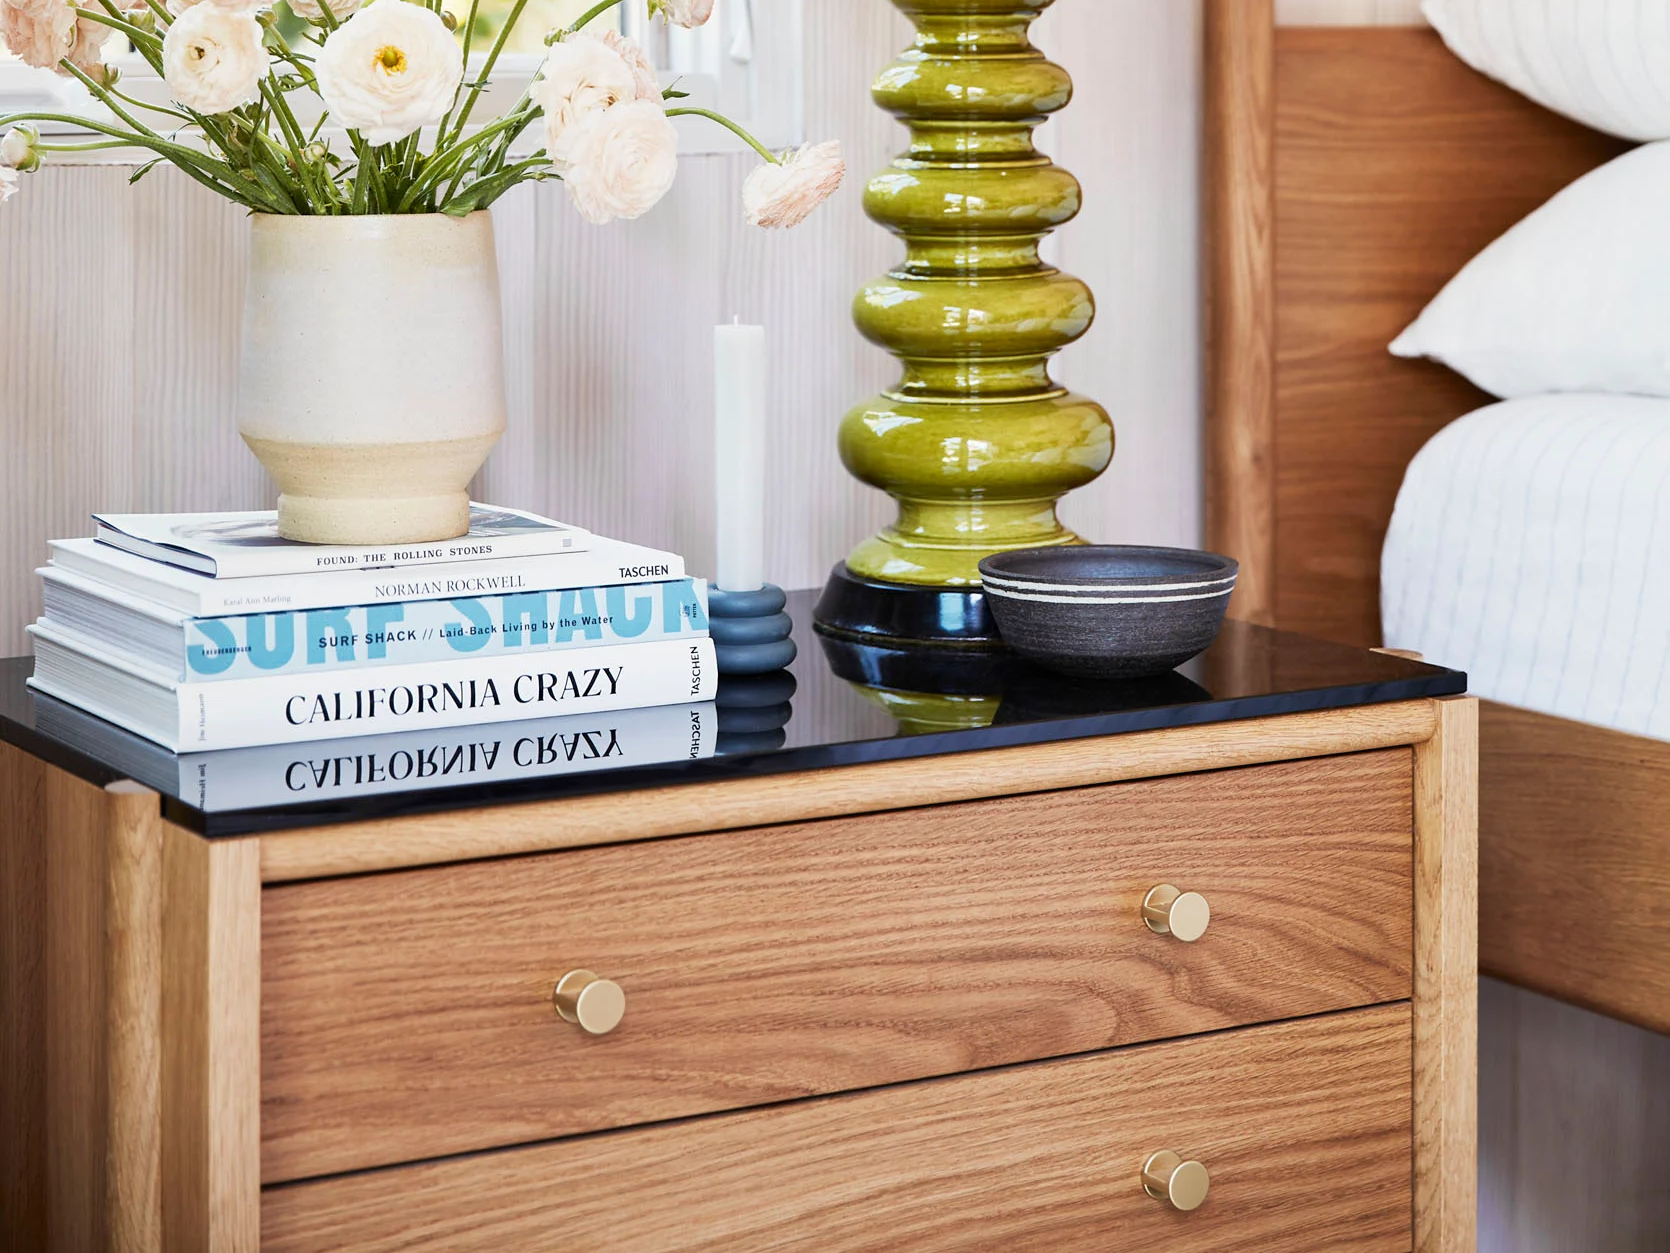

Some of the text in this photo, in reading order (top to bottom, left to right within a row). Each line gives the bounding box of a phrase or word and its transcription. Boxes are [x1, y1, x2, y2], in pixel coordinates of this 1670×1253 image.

[316, 545, 493, 566] FOUND: THE ROLLING STONES
[618, 564, 669, 579] TASCHEN
[375, 575, 526, 598] NORMAN ROCKWELL
[245, 595, 261, 606] Ann
[262, 593, 292, 605] Marling
[318, 634, 359, 649] SURF
[365, 629, 418, 645] SHACK
[439, 624, 498, 639] Laid-Back
[502, 621, 538, 633] Living
[541, 619, 555, 631] by
[559, 617, 578, 628] the
[581, 615, 614, 626] Water
[689, 646, 701, 697] TASCHEN
[285, 666, 624, 725] CALIFORNIA CRAZY
